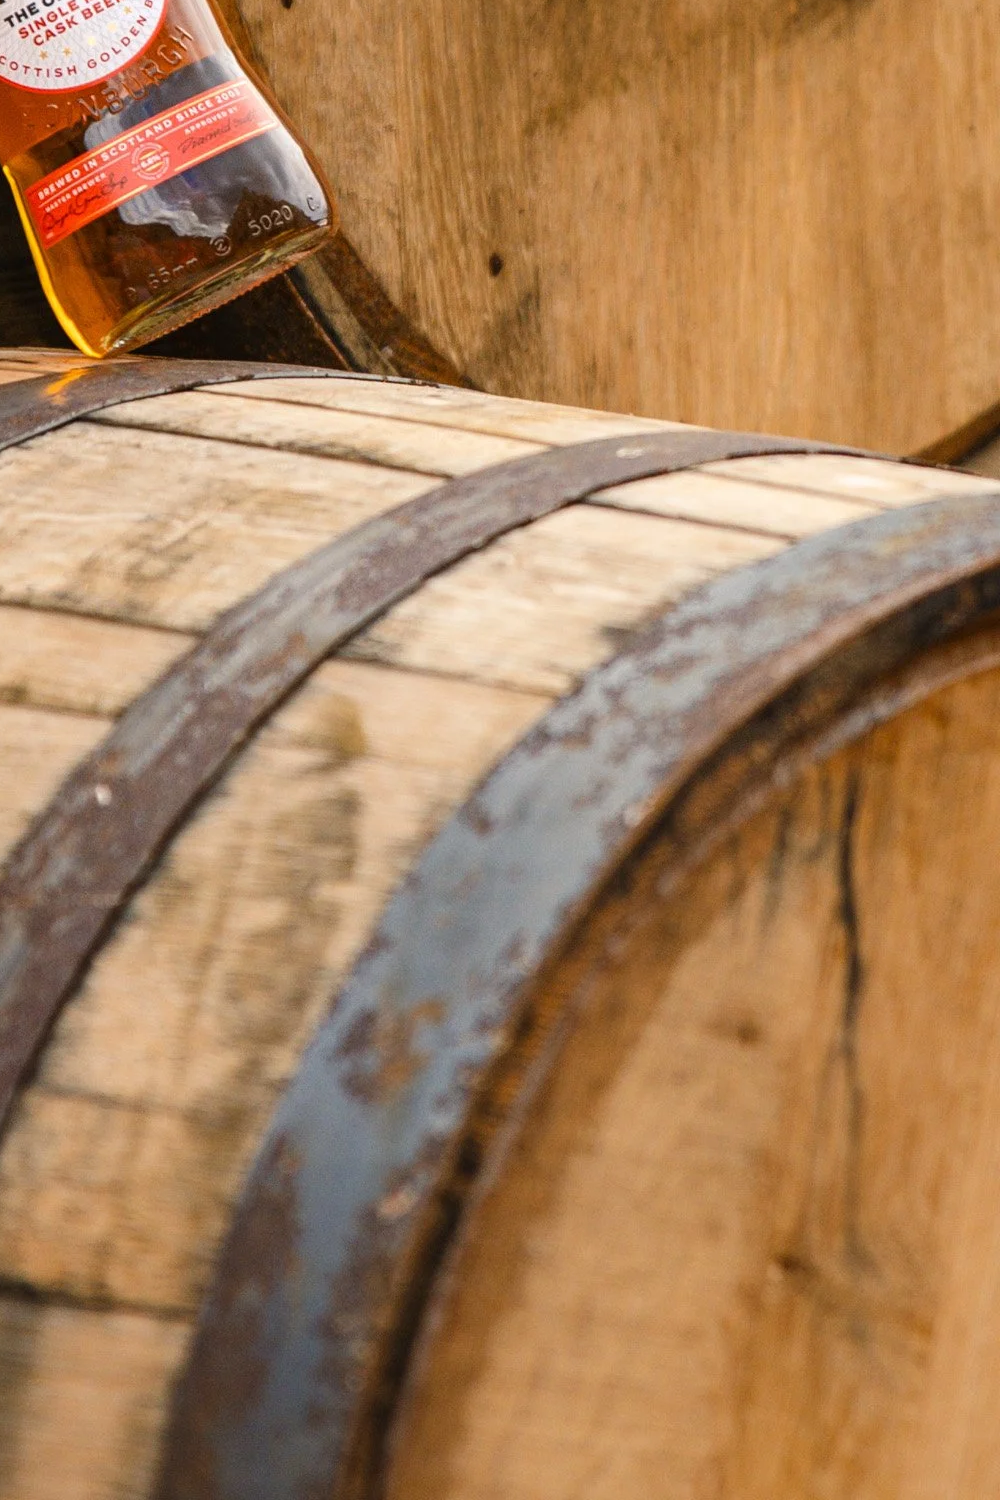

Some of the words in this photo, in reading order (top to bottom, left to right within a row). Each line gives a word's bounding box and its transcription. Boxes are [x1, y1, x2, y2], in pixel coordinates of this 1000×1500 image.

[4, 4, 39, 28] THE
[33, 18, 78, 47] CASK
[87, 14, 148, 70] GOLDEN
[38, 168, 81, 200] BREWED
[83, 158, 98, 172] IN
[100, 118, 173, 162] SCOTLAND
[175, 99, 214, 122] SINCE
[248, 204, 294, 236] 5020
